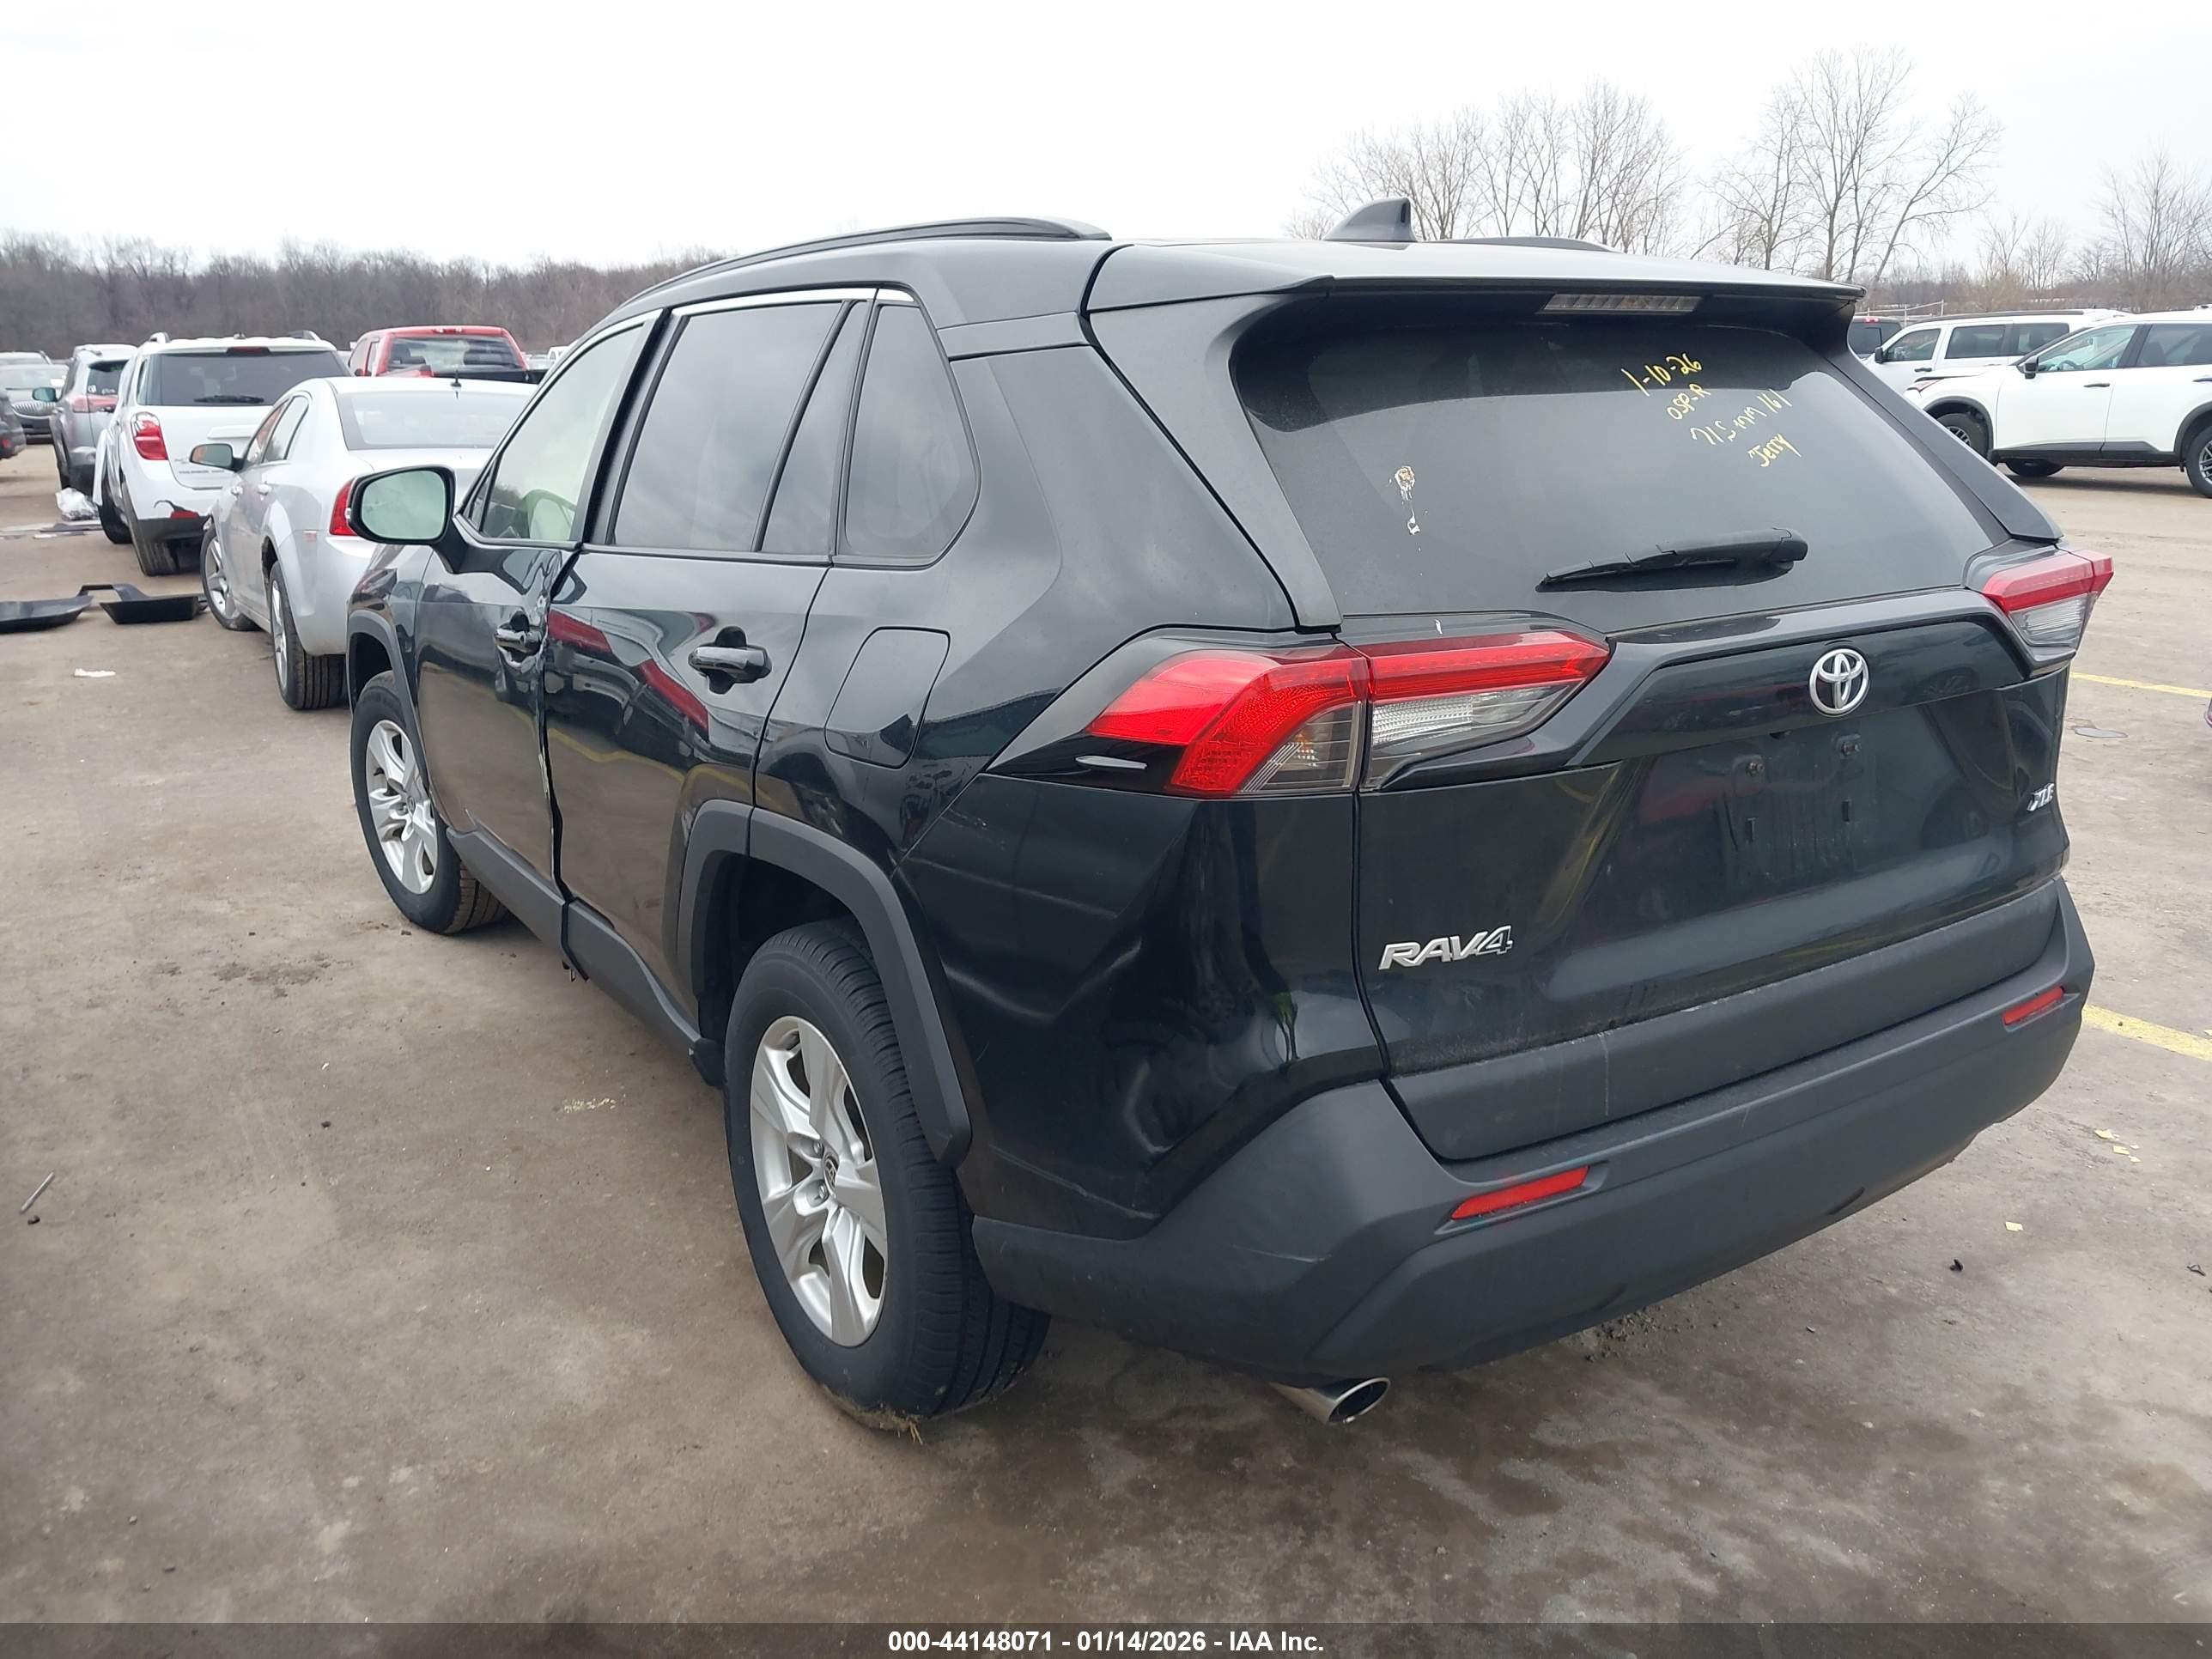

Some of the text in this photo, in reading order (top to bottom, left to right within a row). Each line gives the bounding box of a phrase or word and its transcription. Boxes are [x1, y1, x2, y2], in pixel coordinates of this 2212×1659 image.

[1620, 354, 1702, 397] 1-10-26
[1747, 434, 1802, 467] Jerry
[1378, 925, 1513, 970] RAV4
